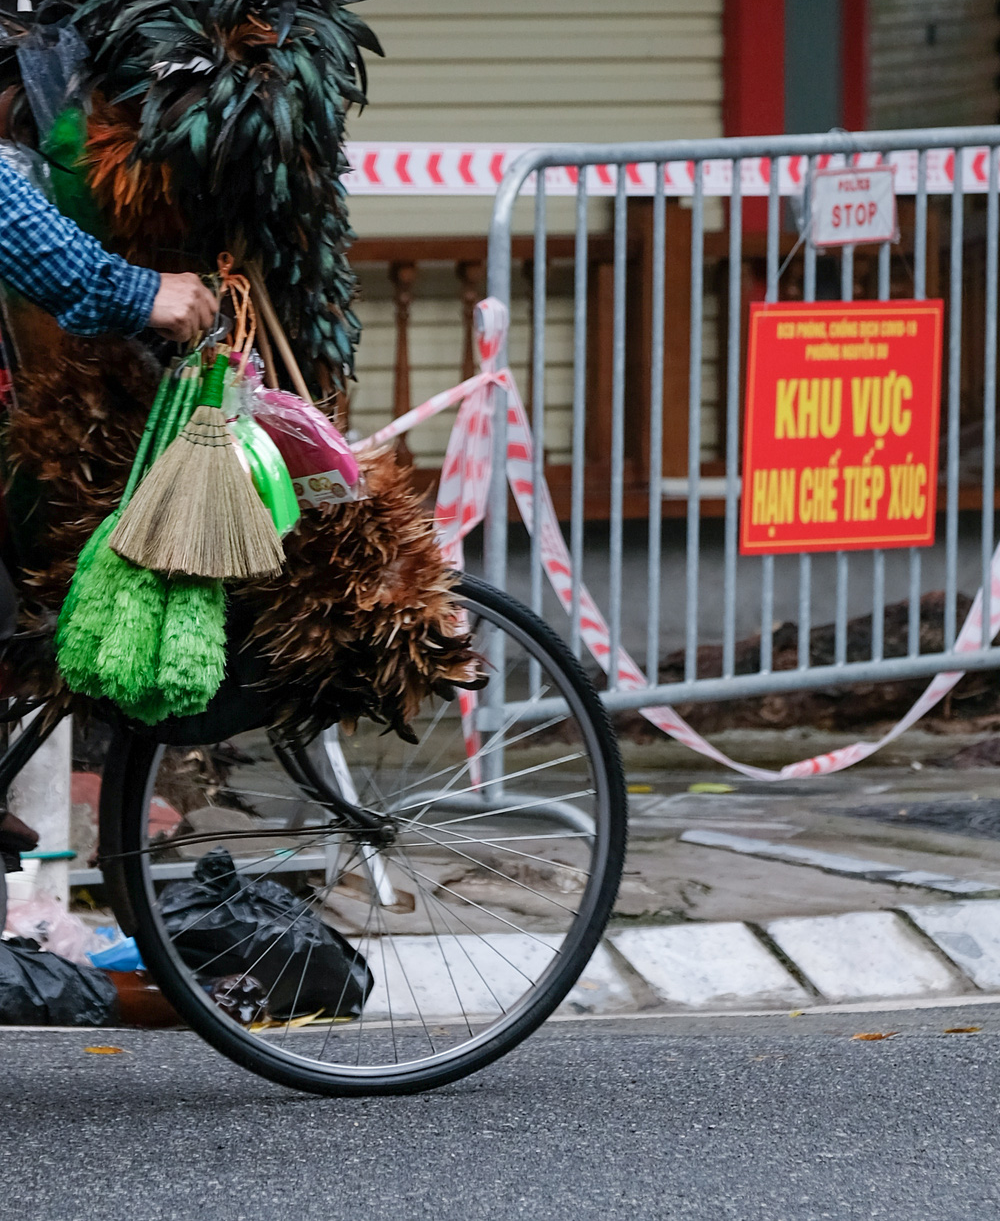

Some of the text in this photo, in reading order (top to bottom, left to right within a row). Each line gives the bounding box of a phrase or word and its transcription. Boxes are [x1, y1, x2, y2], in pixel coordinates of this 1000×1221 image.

[831, 200, 878, 229] STOP
[774, 370, 913, 450] KHU VỰC
[752, 448, 927, 538] HẠN CHẾ TIẾP XÚC
